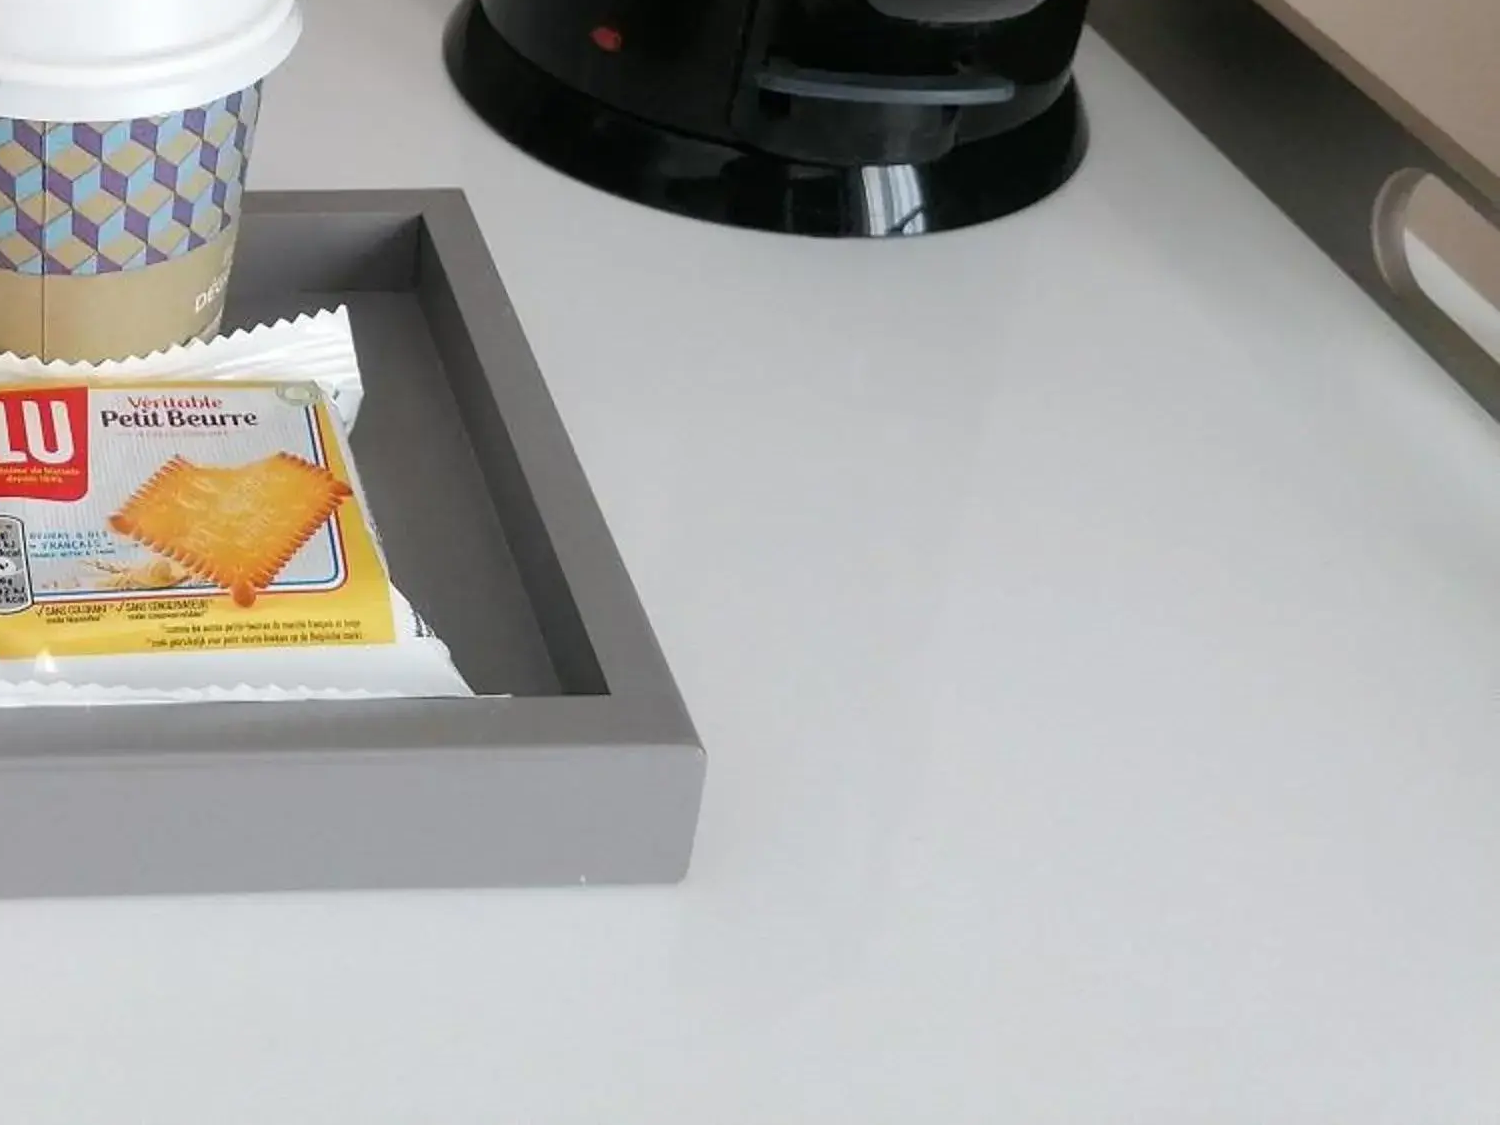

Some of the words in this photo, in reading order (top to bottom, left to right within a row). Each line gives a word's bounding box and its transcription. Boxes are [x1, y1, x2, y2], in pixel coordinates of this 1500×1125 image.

[127, 394, 223, 410] Véritable
[101, 410, 160, 428] Petit
[166, 409, 257, 426] Beurre
